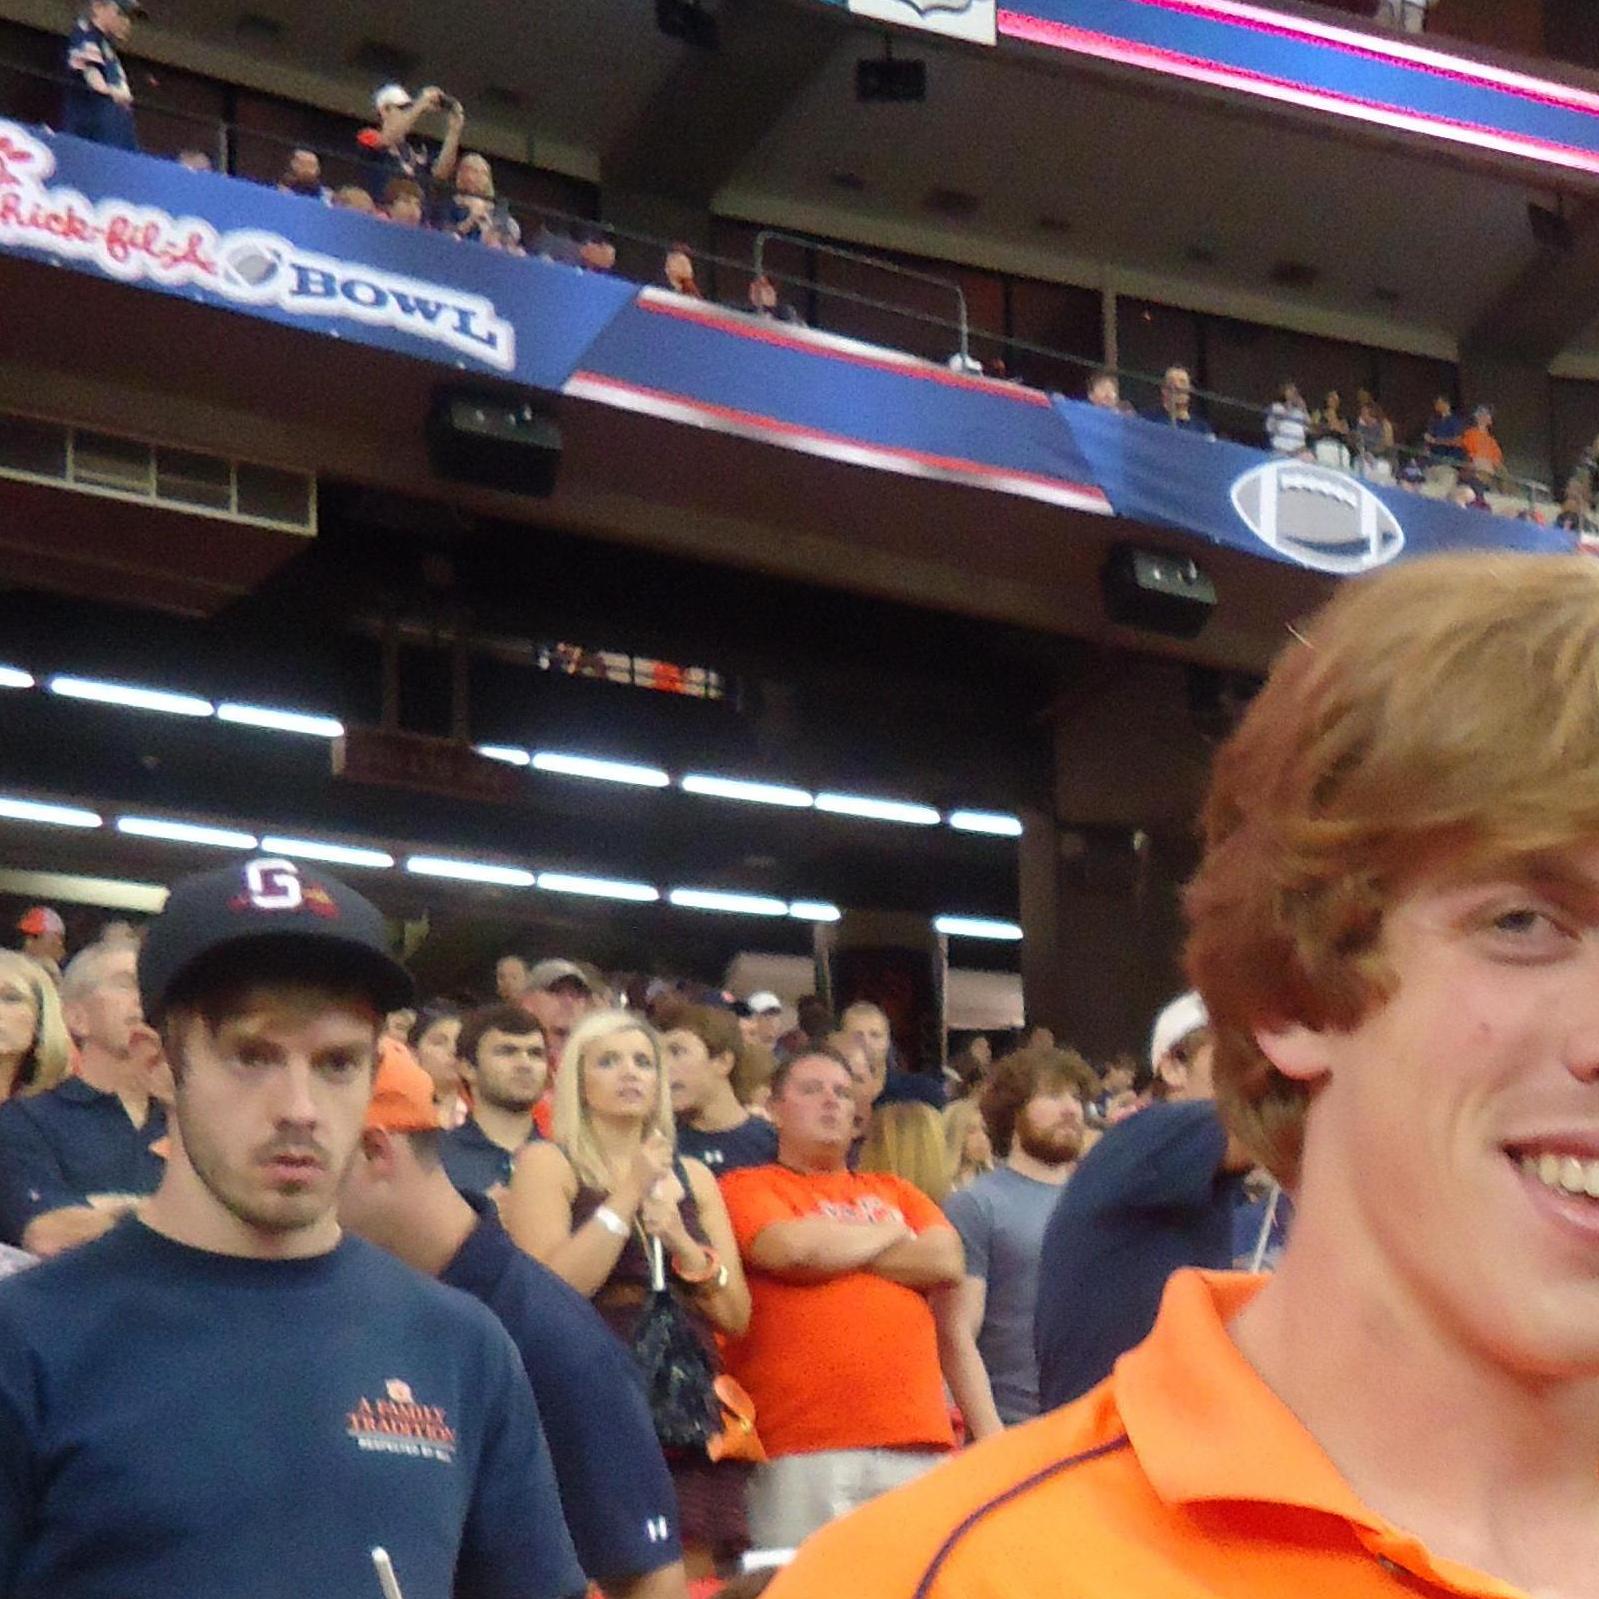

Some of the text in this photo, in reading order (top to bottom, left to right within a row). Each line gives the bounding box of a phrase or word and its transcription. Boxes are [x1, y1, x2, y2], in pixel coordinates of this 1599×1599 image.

[0, 162, 498, 350] hick-fil-A BOWL
[246, 858, 302, 909] G
